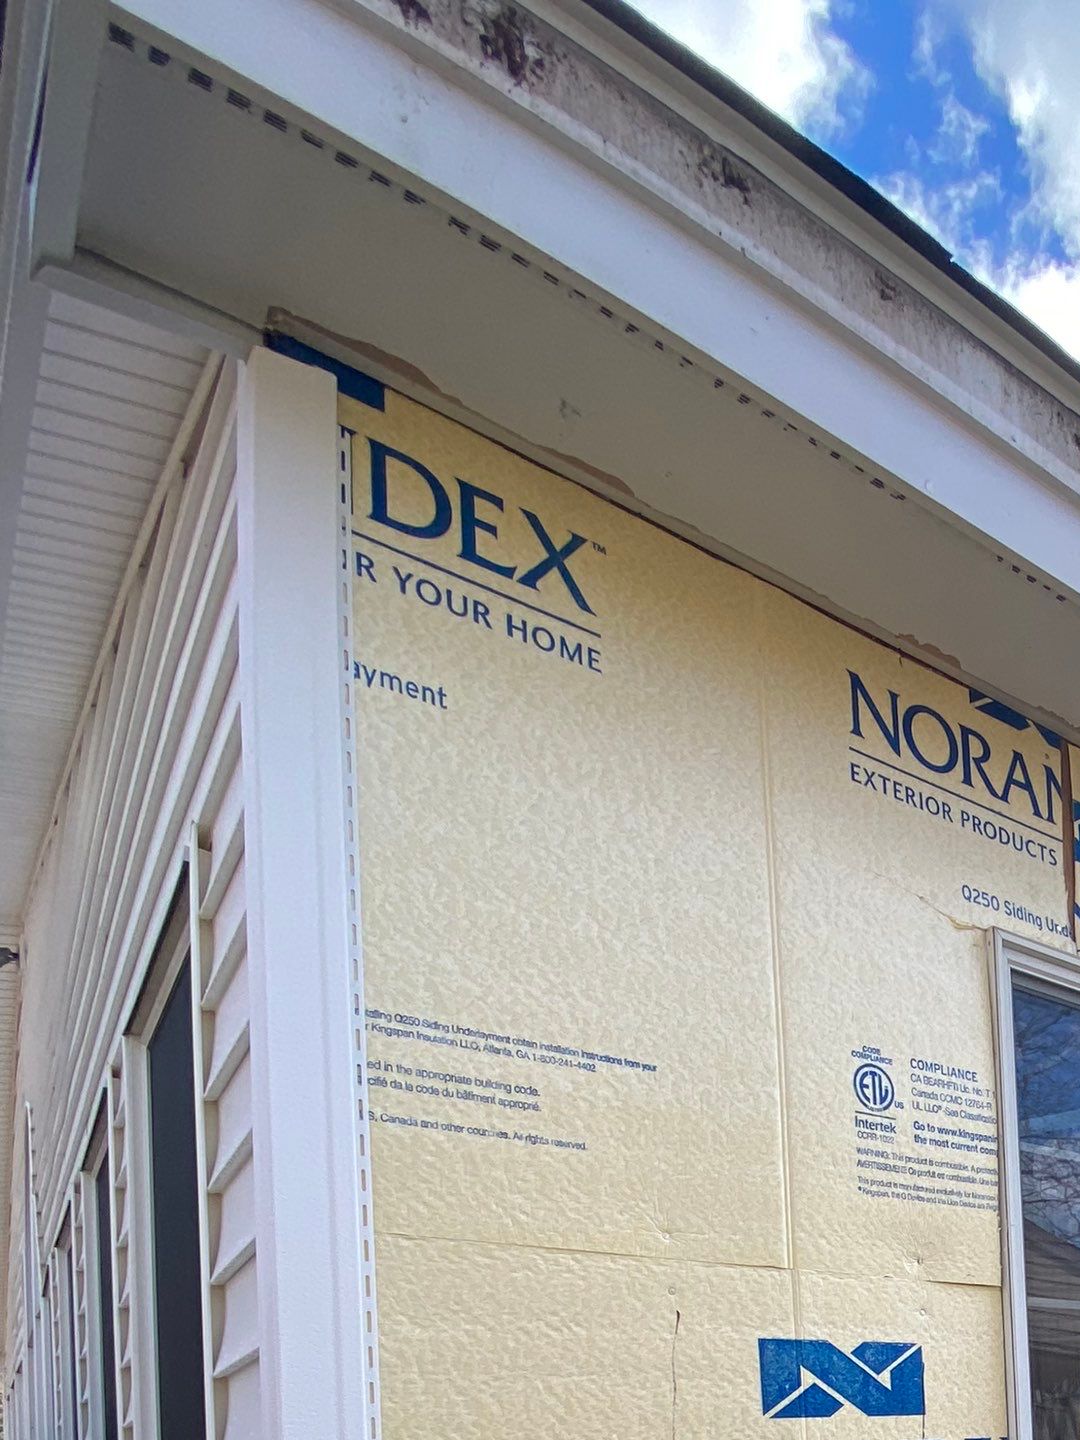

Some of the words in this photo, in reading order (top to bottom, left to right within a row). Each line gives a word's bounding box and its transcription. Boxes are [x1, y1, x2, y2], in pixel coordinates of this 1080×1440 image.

[392, 566, 493, 630] YOUR
[505, 613, 602, 674] HOME
[849, 762, 954, 824] EXTERIOR
[960, 808, 1059, 868] PRODUCTS
[961, 884, 1001, 912] Q250
[1003, 903, 1043, 931] Siding
[371, 1023, 415, 1040] Kingspan
[416, 1031, 459, 1048] Insulation
[451, 1024, 511, 1045] Underlayment
[851, 1050, 893, 1066] COMPLIANCE
[396, 1064, 413, 1076] the
[415, 1068, 473, 1085] appropriate
[474, 1077, 512, 1095] building
[514, 1084, 541, 1098] code.
[910, 1058, 979, 1083] COMPLIANCE
[415, 1083, 440, 1096] code
[441, 1086, 454, 1098] du
[380, 1112, 418, 1127] Canada
[421, 1119, 439, 1130] and
[441, 1121, 465, 1134] other
[854, 1115, 897, 1134] Intertek
[913, 1120, 926, 1131] Go
[927, 1123, 936, 1134] to
[914, 1134, 928, 1145] the
[929, 1137, 949, 1149] most
[950, 1141, 978, 1154] current
